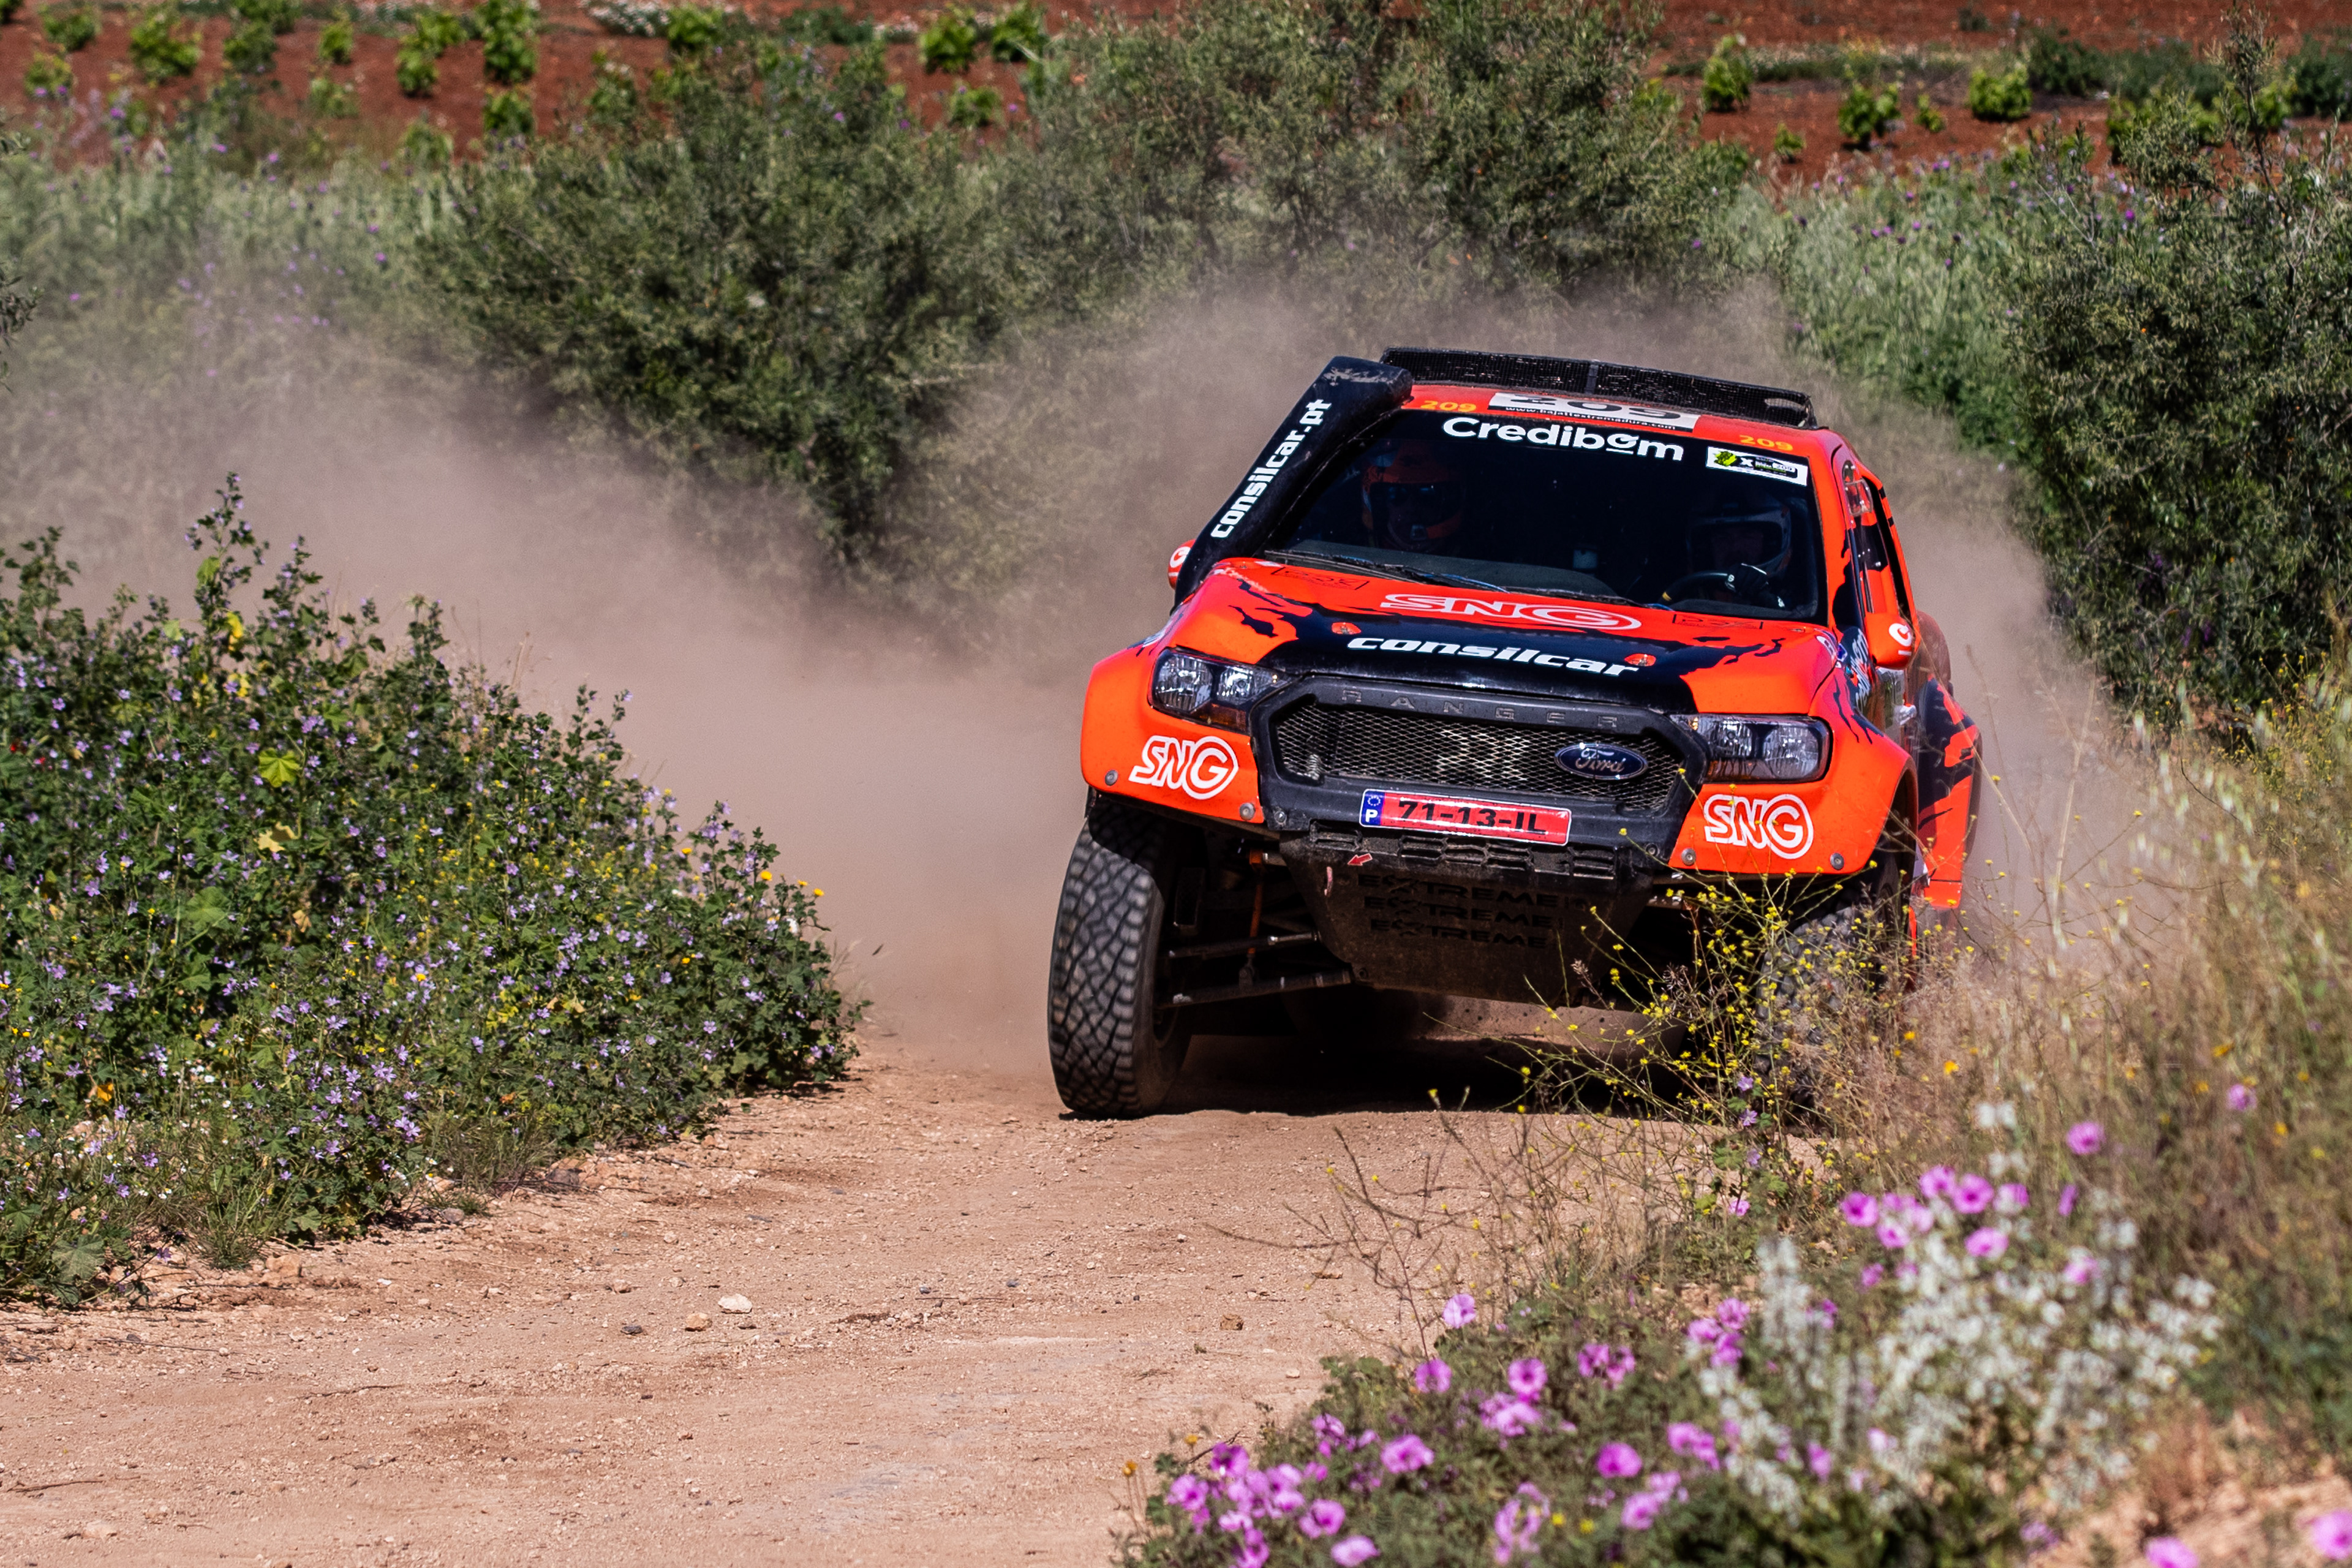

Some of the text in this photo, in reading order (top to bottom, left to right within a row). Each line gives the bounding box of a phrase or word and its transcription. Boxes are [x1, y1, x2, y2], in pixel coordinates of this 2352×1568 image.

[1420, 400, 1477, 412] 209
[1442, 417, 1684, 461] Credibom
[1739, 435, 1793, 451] 209
[1210, 399, 1332, 538] consilcar.pt
[1380, 594, 1642, 630] SNG
[1348, 638, 1639, 676] consilcar
[1341, 689, 1618, 728] RANGER
[1129, 735, 1239, 799] SNG
[1575, 748, 1625, 772] Ford
[1365, 809, 1378, 822] P
[1398, 801, 1547, 835] 71-13-IL
[1704, 794, 1814, 859] SNG
[1358, 874, 1558, 907] EXTREME
